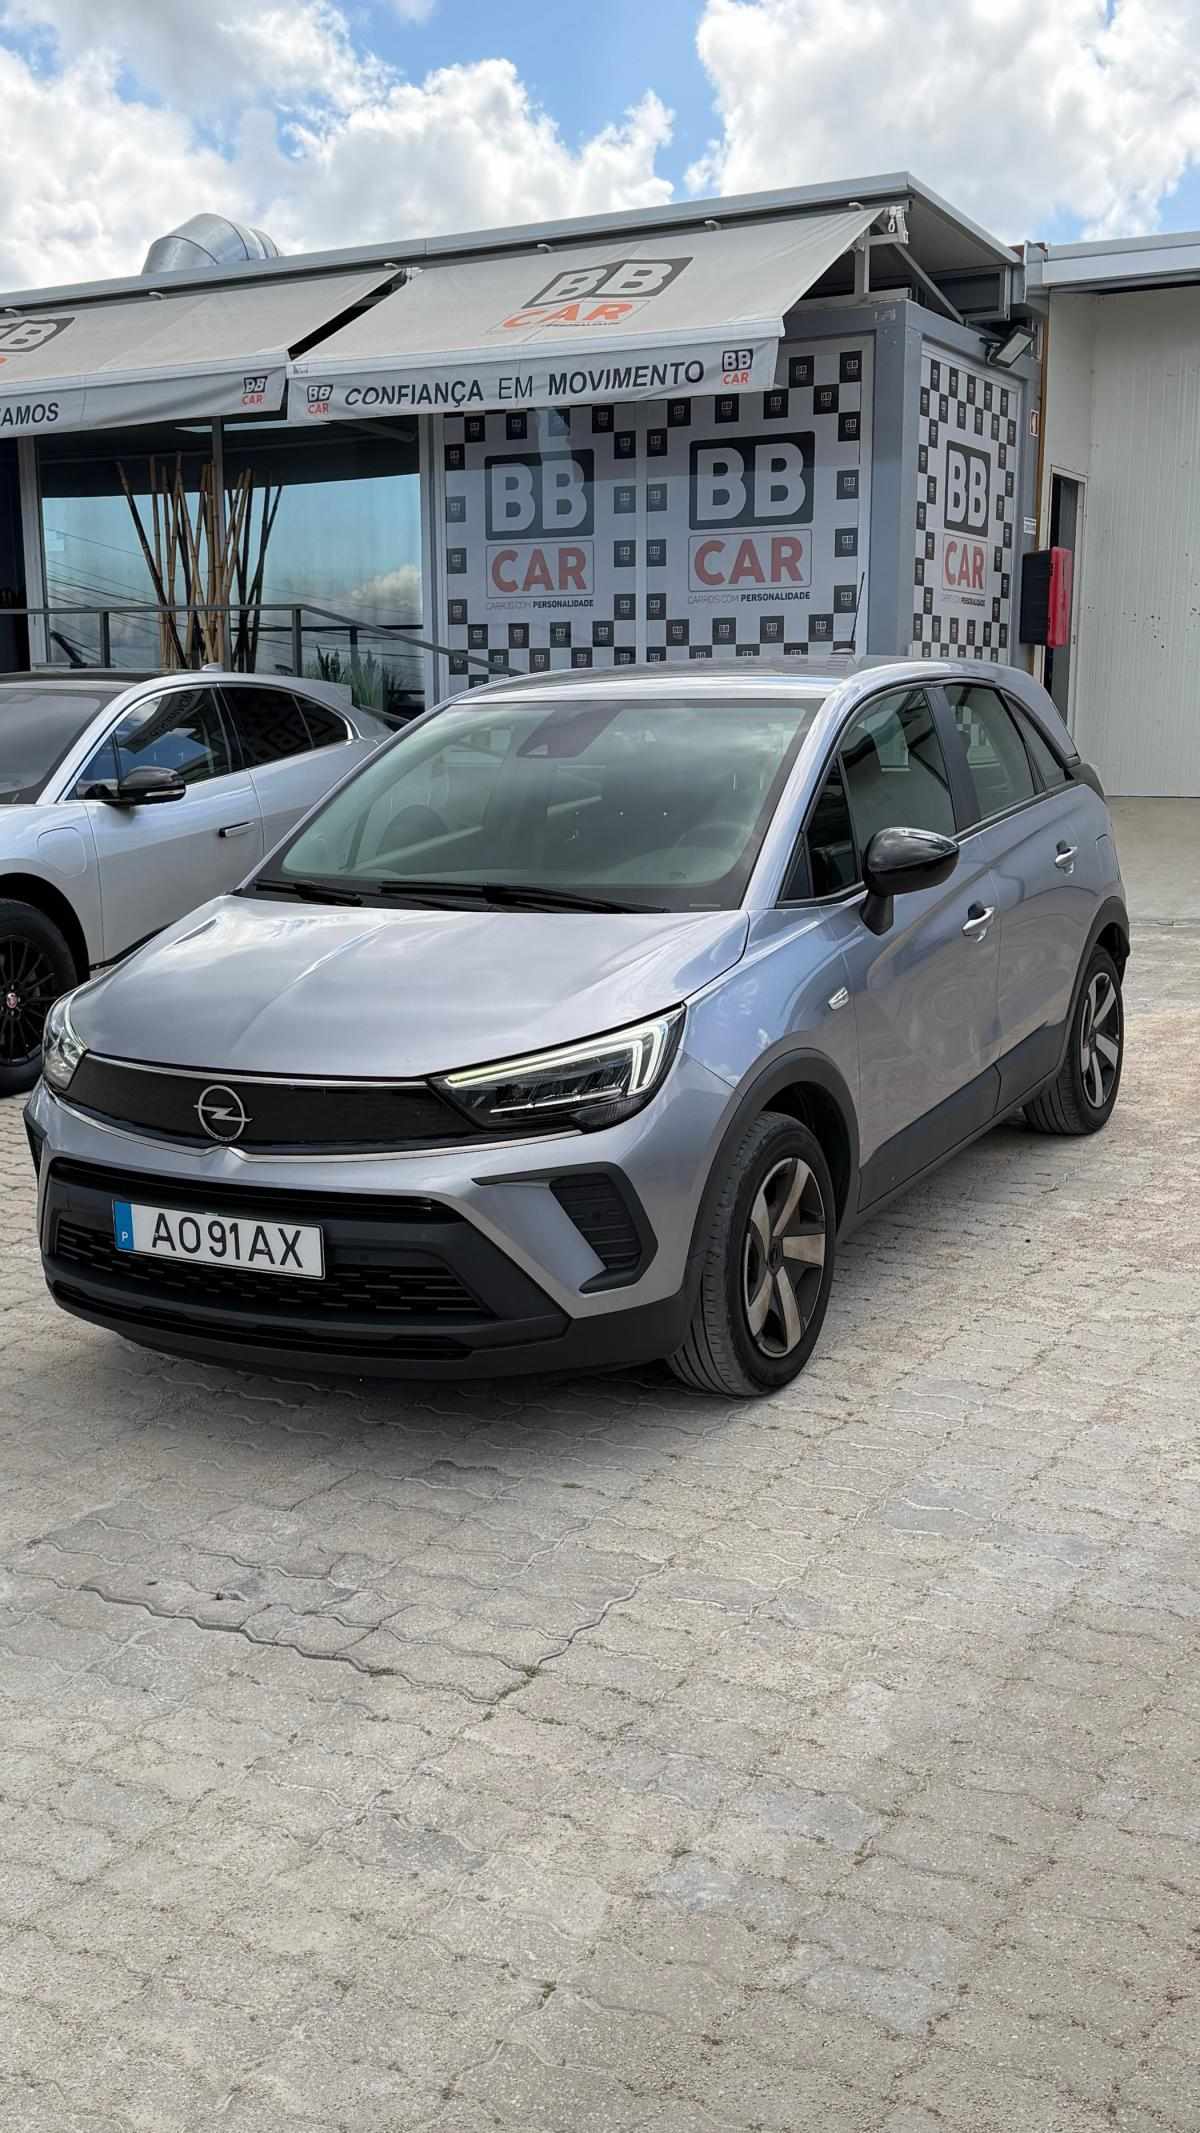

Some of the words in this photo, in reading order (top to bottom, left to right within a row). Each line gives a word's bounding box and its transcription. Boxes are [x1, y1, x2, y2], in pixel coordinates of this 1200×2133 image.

[533, 263, 672, 304] BB
[503, 303, 633, 328] CAR
[723, 351, 752, 370] BB
[345, 380, 484, 407] CONFIANÇA
[498, 376, 533, 399] EM
[548, 360, 704, 395] MOVIMENTO
[723, 372, 749, 384] CAR
[242, 394, 263, 405] CAR
[308, 385, 332, 401] BB
[0, 402, 59, 426] AMOS
[308, 403, 328, 414] CAR
[697, 443, 806, 520] BB
[947, 450, 987, 527] BB
[491, 460, 587, 532] BB
[491, 547, 587, 592] CAR
[694, 537, 803, 585] CAR
[945, 541, 984, 589] CAR
[533, 600, 594, 608] PERSONALIDADE
[740, 592, 810, 602] PERSONALIDADE
[121, 1231, 129, 1242] P
